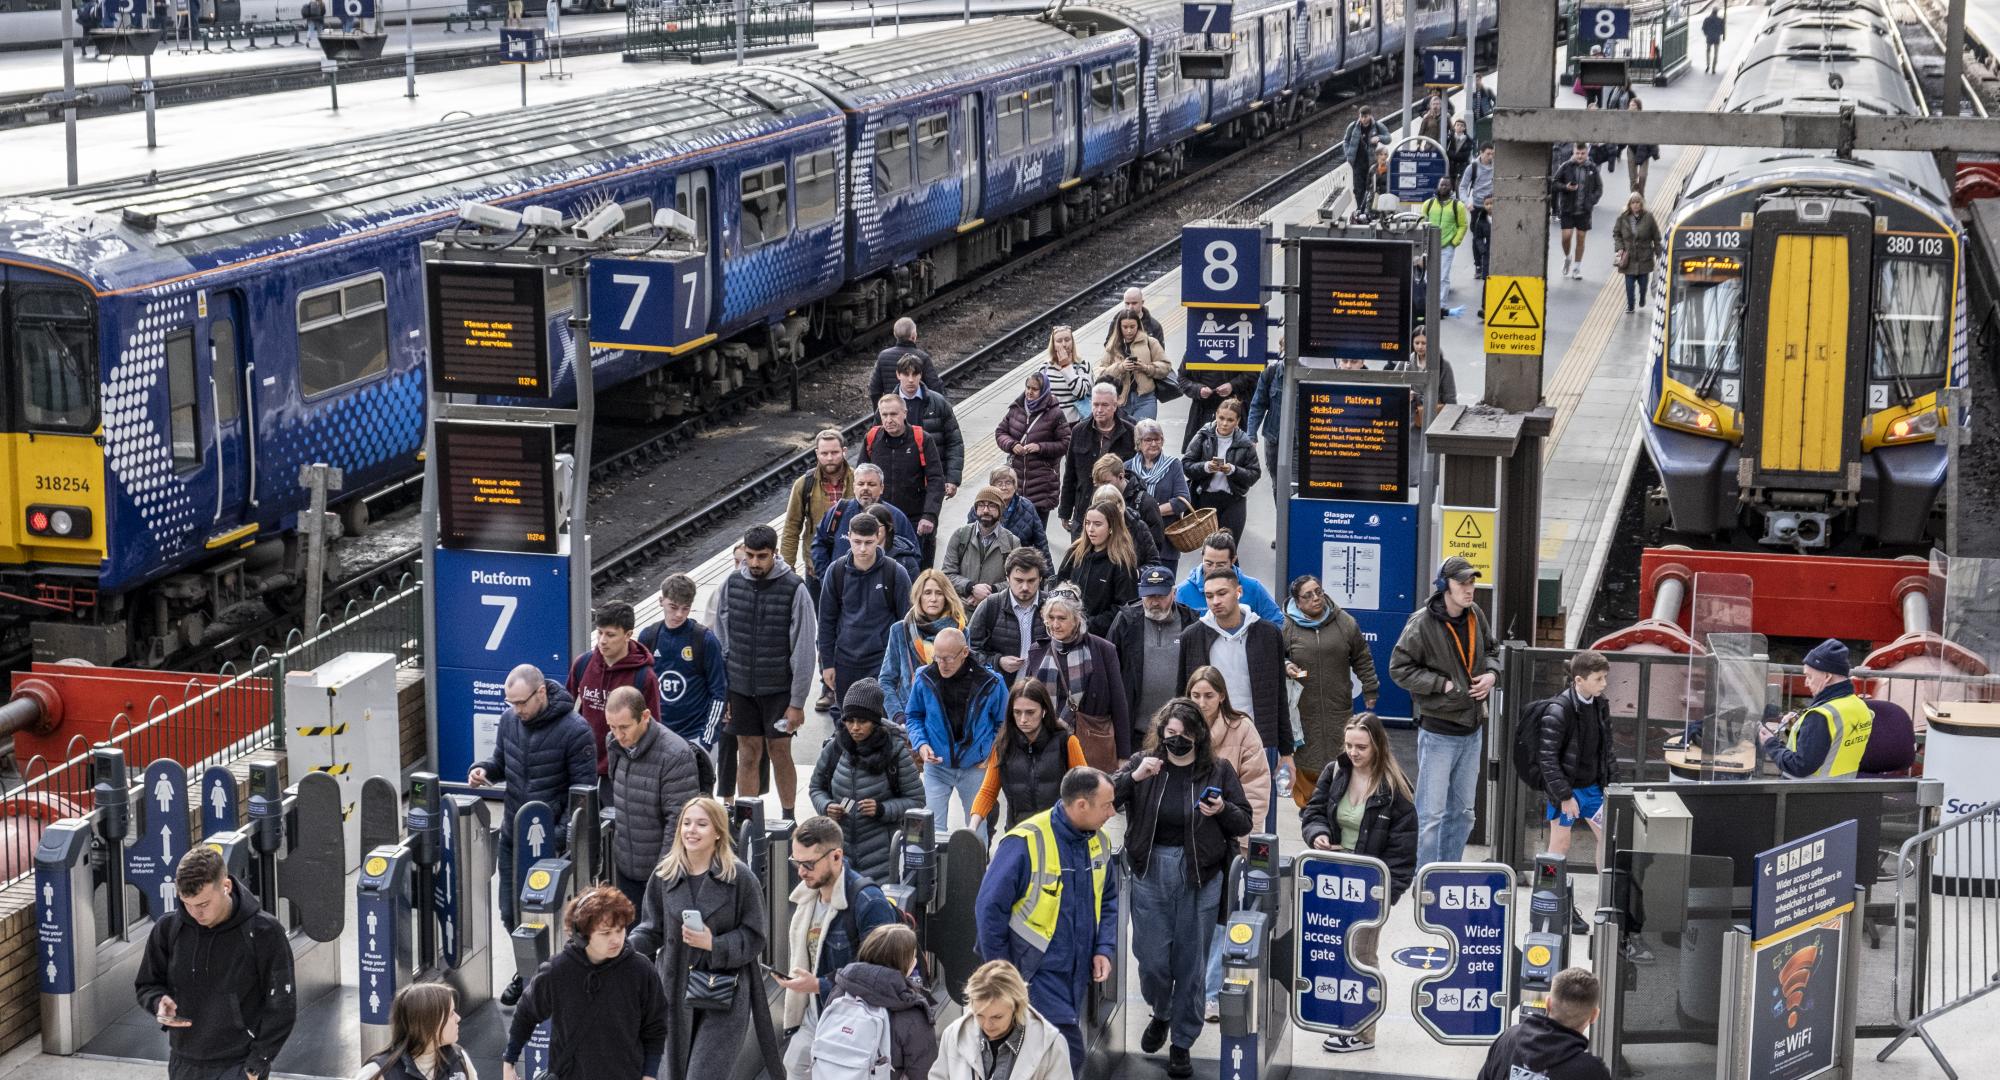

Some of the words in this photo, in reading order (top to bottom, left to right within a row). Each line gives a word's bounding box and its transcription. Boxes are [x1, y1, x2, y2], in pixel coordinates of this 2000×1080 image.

[1198, 4, 1217, 32] 7
[1594, 9, 1616, 39] 8
[1685, 231, 1711, 248] 380
[1715, 231, 1741, 248] 103
[1886, 236, 1913, 254] 380
[1917, 238, 1943, 255] 103
[1202, 240, 1239, 291] 8
[682, 271, 698, 329] 7
[1332, 291, 1356, 299] Please
[613, 273, 650, 331] 7
[464, 320, 489, 329] Please
[491, 321, 513, 330] check
[471, 330, 506, 338] timetable
[1490, 331, 1536, 341] Overhead
[465, 338, 478, 346] for
[480, 340, 513, 348] services
[1198, 339, 1236, 349] TICKETS
[1490, 341, 1506, 349] live
[1511, 343, 1536, 351] wires
[1725, 384, 1735, 397] 2
[1875, 390, 1883, 403] 2
[1311, 394, 1330, 403] 11:36
[1344, 395, 1374, 405] Platform
[35, 475, 90, 492] 318254
[472, 478, 497, 486] Please
[499, 479, 521, 487] check
[479, 487, 514, 495] timetable
[1324, 511, 1355, 519] Glasgow
[471, 570, 531, 586] Platform
[481, 595, 518, 650] 7
[473, 688, 502, 696] Central
[583, 685, 600, 699] Jack
[662, 679, 681, 692] BT
[1776, 879, 1792, 890] Wider
[1793, 872, 1810, 884] access
[1811, 867, 1823, 879] gate
[1776, 887, 1798, 903] available
[1799, 884, 1807, 893] for
[1808, 874, 1836, 890] customers
[1836, 870, 1842, 879] in
[1776, 896, 1806, 914] wheelchairs
[1814, 887, 1826, 898] with
[1794, 908, 1807, 919] bikes
[1808, 905, 1814, 913] or
[1815, 897, 1836, 911] luggage
[1306, 912, 1341, 928] Wider
[1465, 925, 1501, 938] Wider
[1304, 931, 1342, 946] access
[1310, 949, 1335, 962] gate
[1462, 944, 1502, 955] access
[1468, 960, 1494, 974] gate
[1774, 1040, 1786, 1049] Fast
[1786, 1027, 1813, 1053] WiFi
[1774, 1049, 1786, 1060] Free
